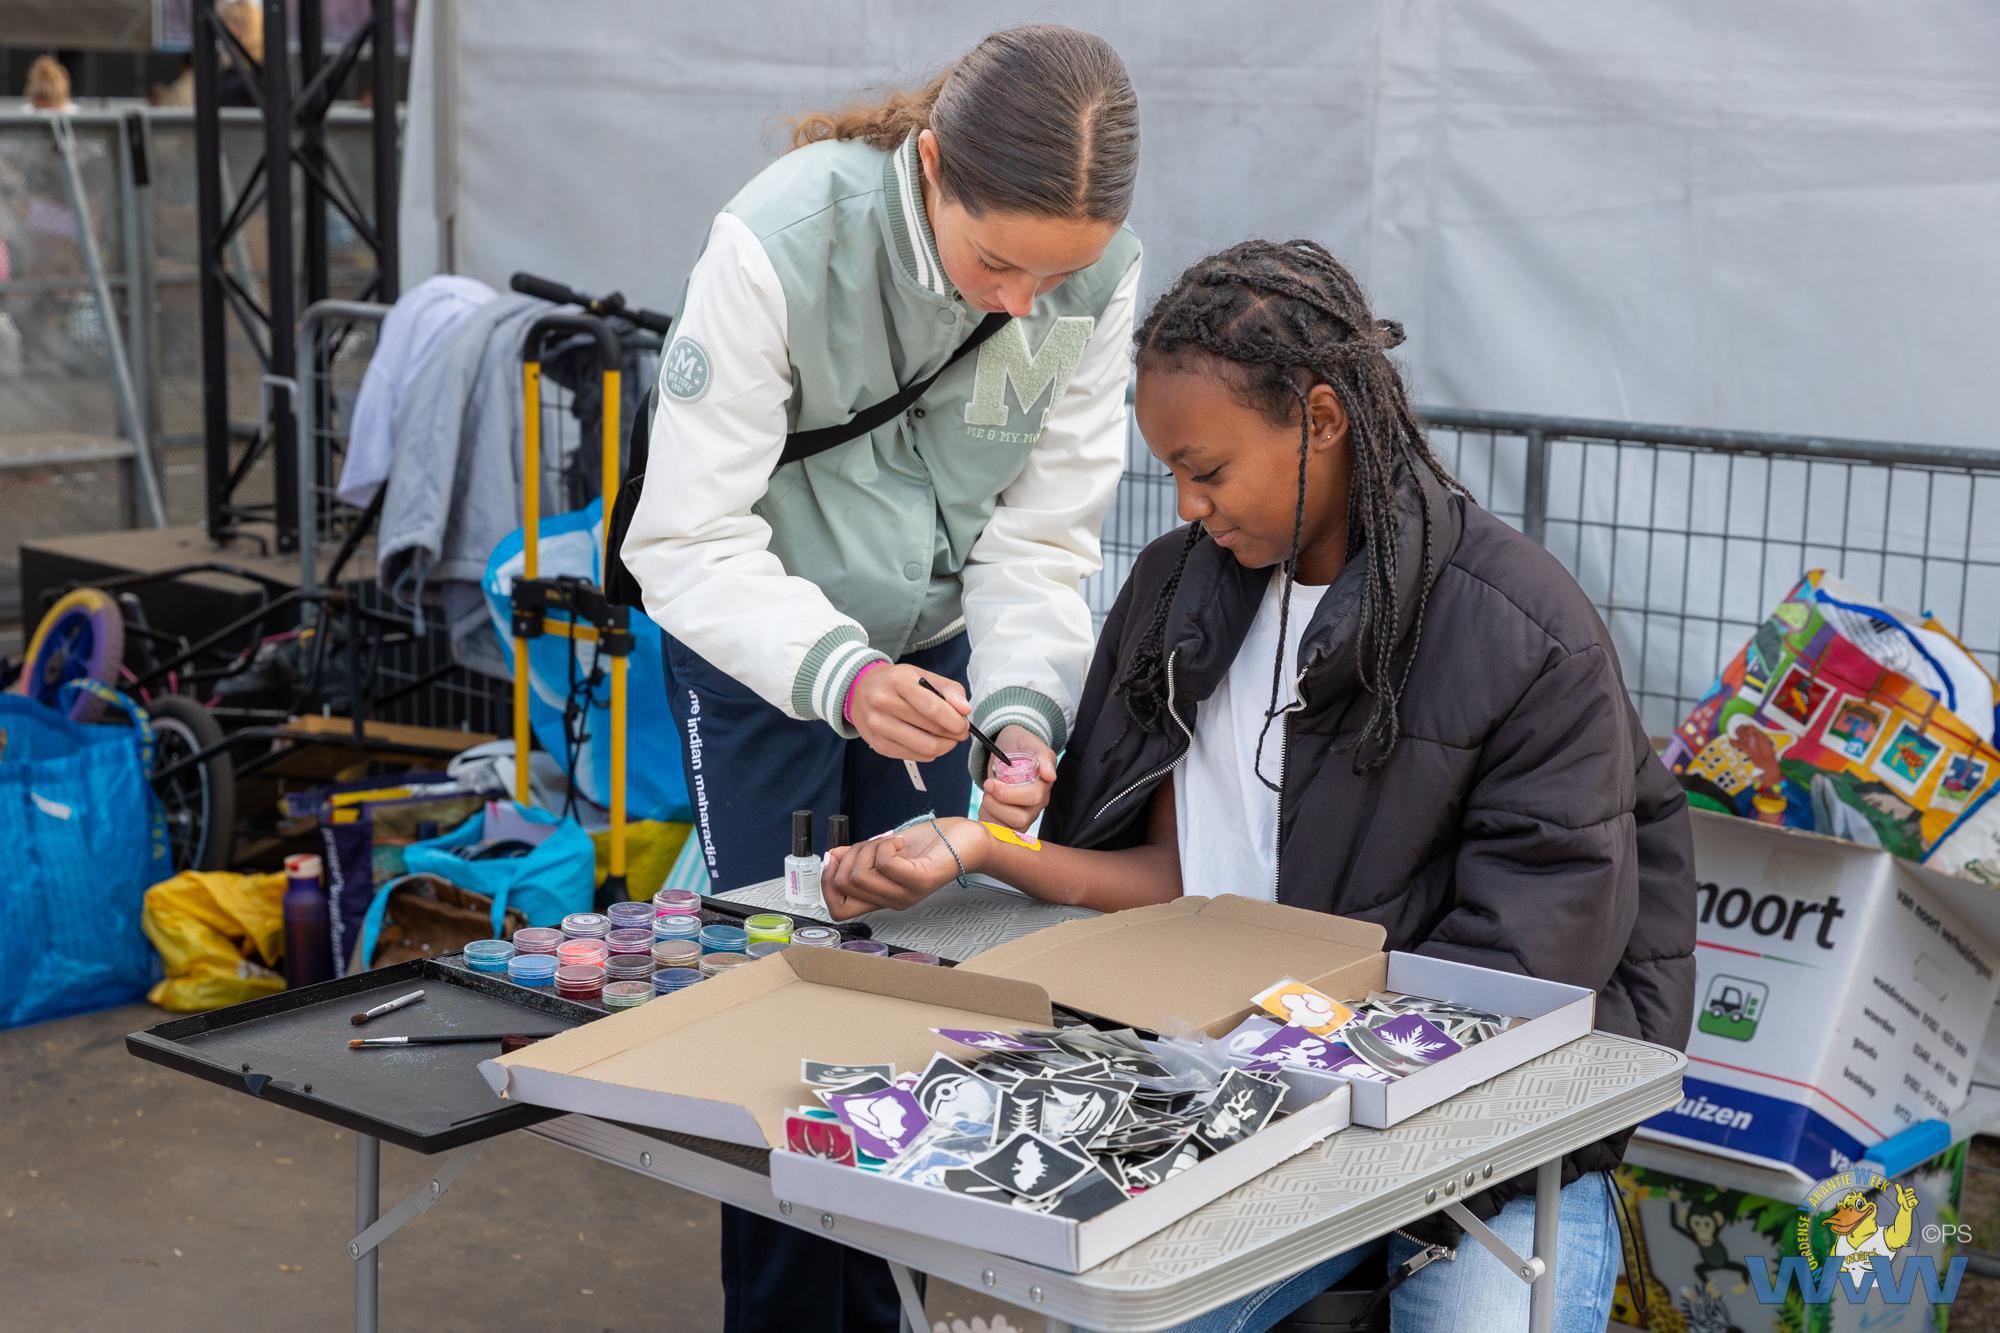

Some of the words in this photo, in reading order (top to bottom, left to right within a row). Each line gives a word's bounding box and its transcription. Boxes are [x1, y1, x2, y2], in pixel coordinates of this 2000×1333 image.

[673, 348, 698, 380] M
[965, 316, 1096, 427] M
[966, 426, 985, 439] ME
[999, 431, 1020, 443] MY
[687, 716, 703, 770] indian
[694, 774, 716, 866] maharadja
[1697, 882, 1845, 949] noort
[1896, 888, 1915, 912] van
[1914, 904, 1941, 935] noort
[1863, 1006, 1897, 1036] woerden
[1852, 1036, 1878, 1061] gouda
[1843, 1065, 1877, 1099] boskoop
[1667, 1096, 1754, 1131] uizen
